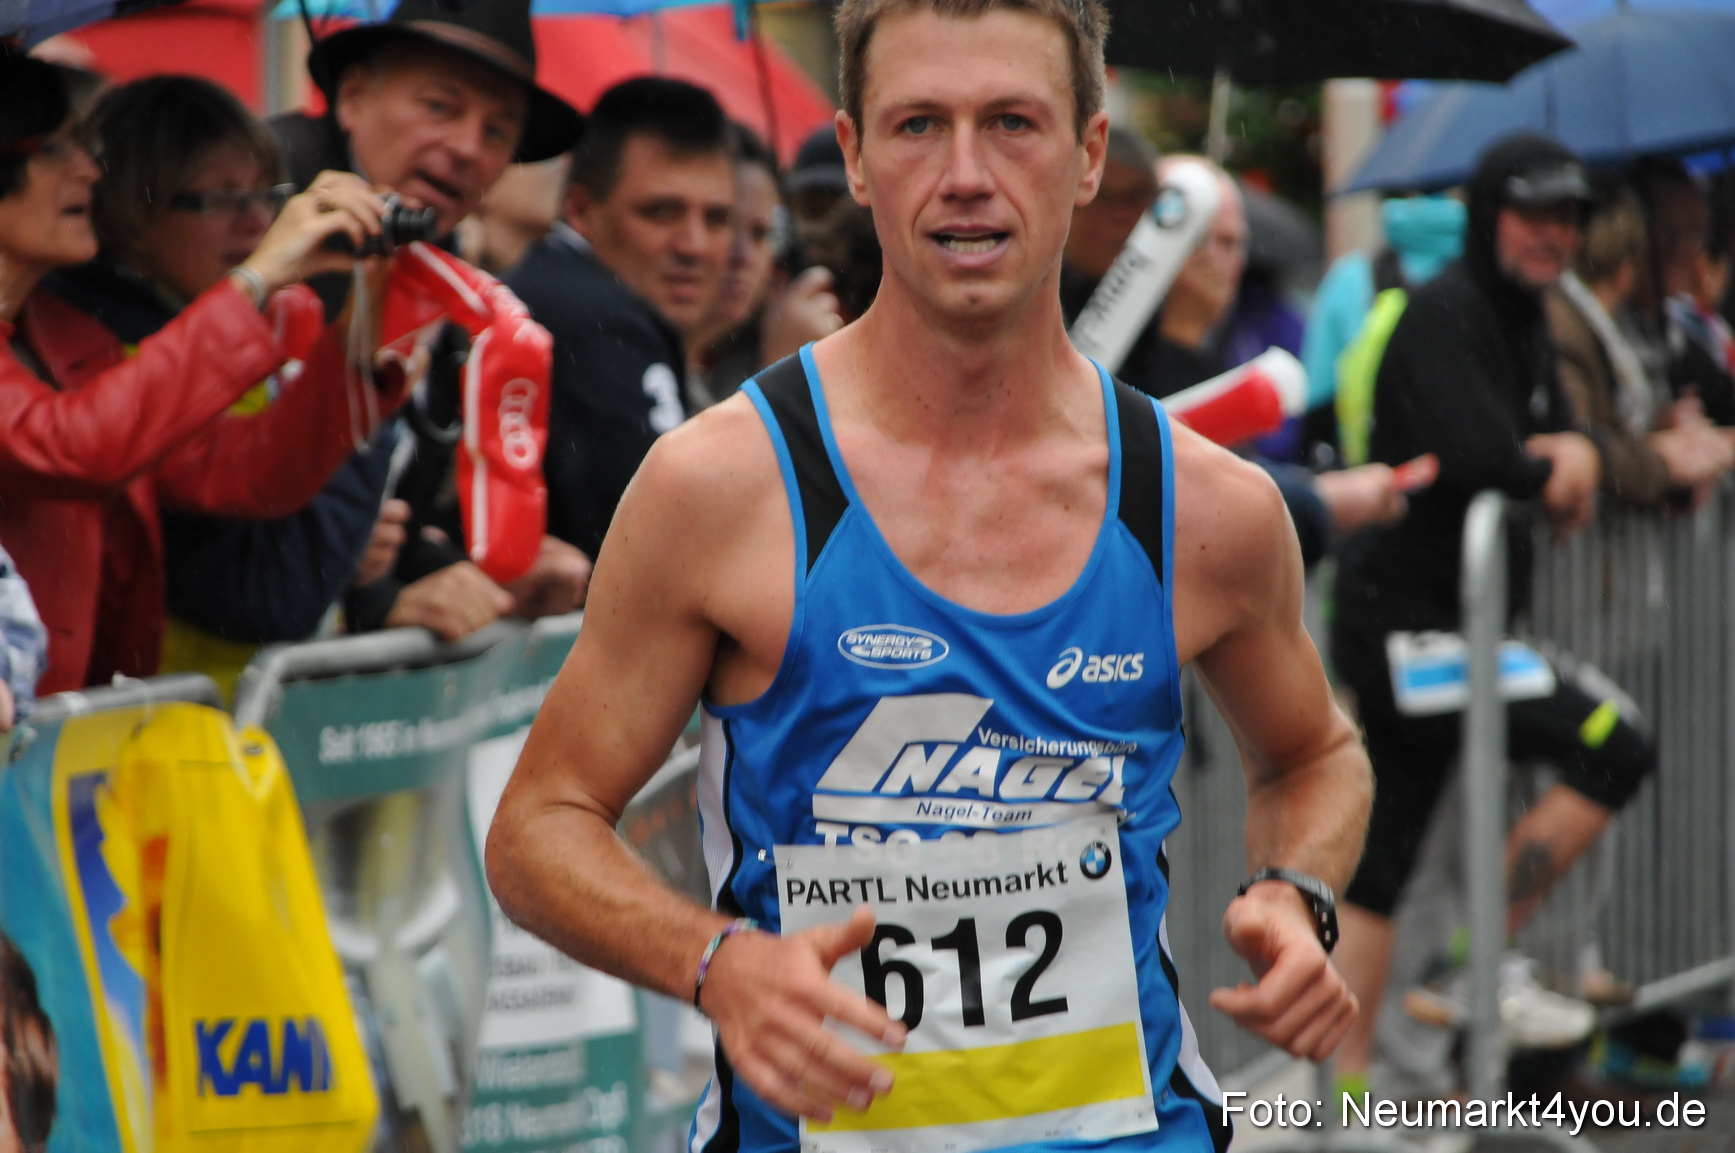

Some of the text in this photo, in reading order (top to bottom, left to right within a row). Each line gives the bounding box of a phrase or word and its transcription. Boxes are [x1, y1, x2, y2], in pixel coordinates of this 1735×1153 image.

[846, 632, 916, 647] SYNERGY
[870, 646, 932, 661] SPORTS
[916, 800, 1032, 822] Nagel-Team
[786, 861, 1069, 906] PARTL Neumarkt
[860, 909, 1069, 1033] 612
